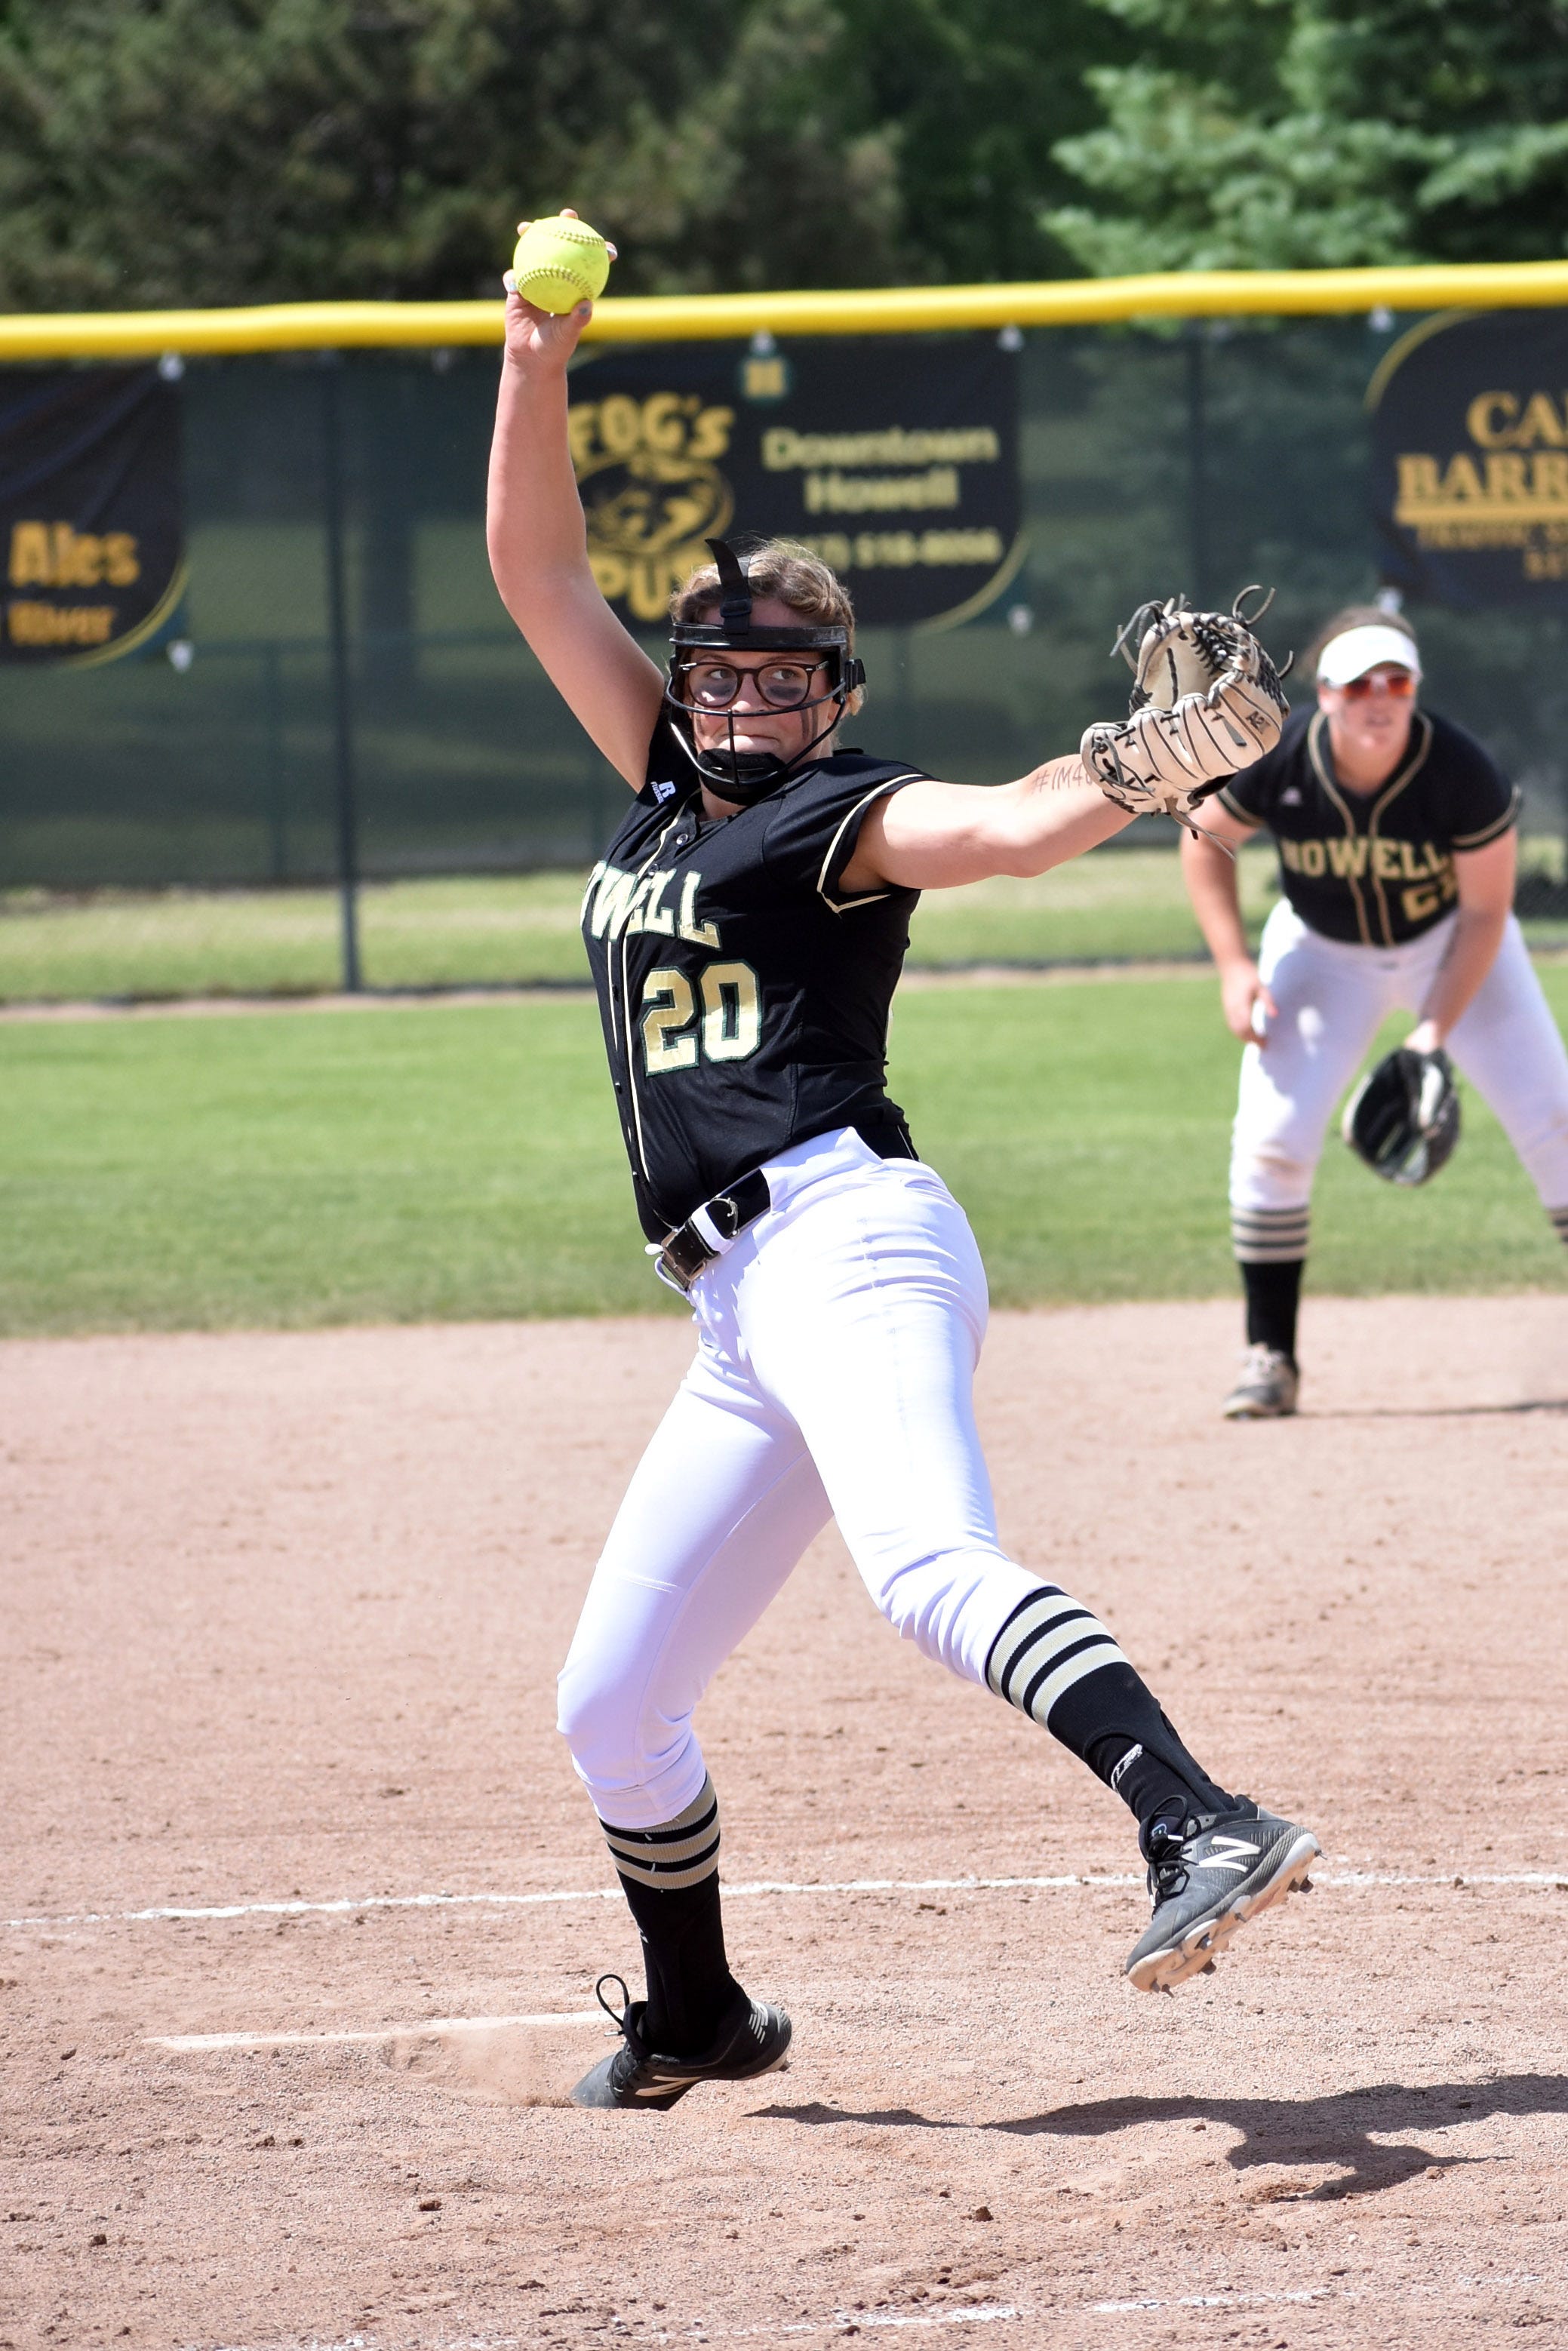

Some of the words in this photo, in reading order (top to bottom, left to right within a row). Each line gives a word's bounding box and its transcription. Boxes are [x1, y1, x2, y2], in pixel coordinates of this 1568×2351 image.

[762, 427, 1000, 471] Downtown
[1467, 391, 1568, 449] CA
[805, 468, 958, 513] Howell
[10, 521, 141, 587] Ales
[640, 958, 763, 1077] 20
